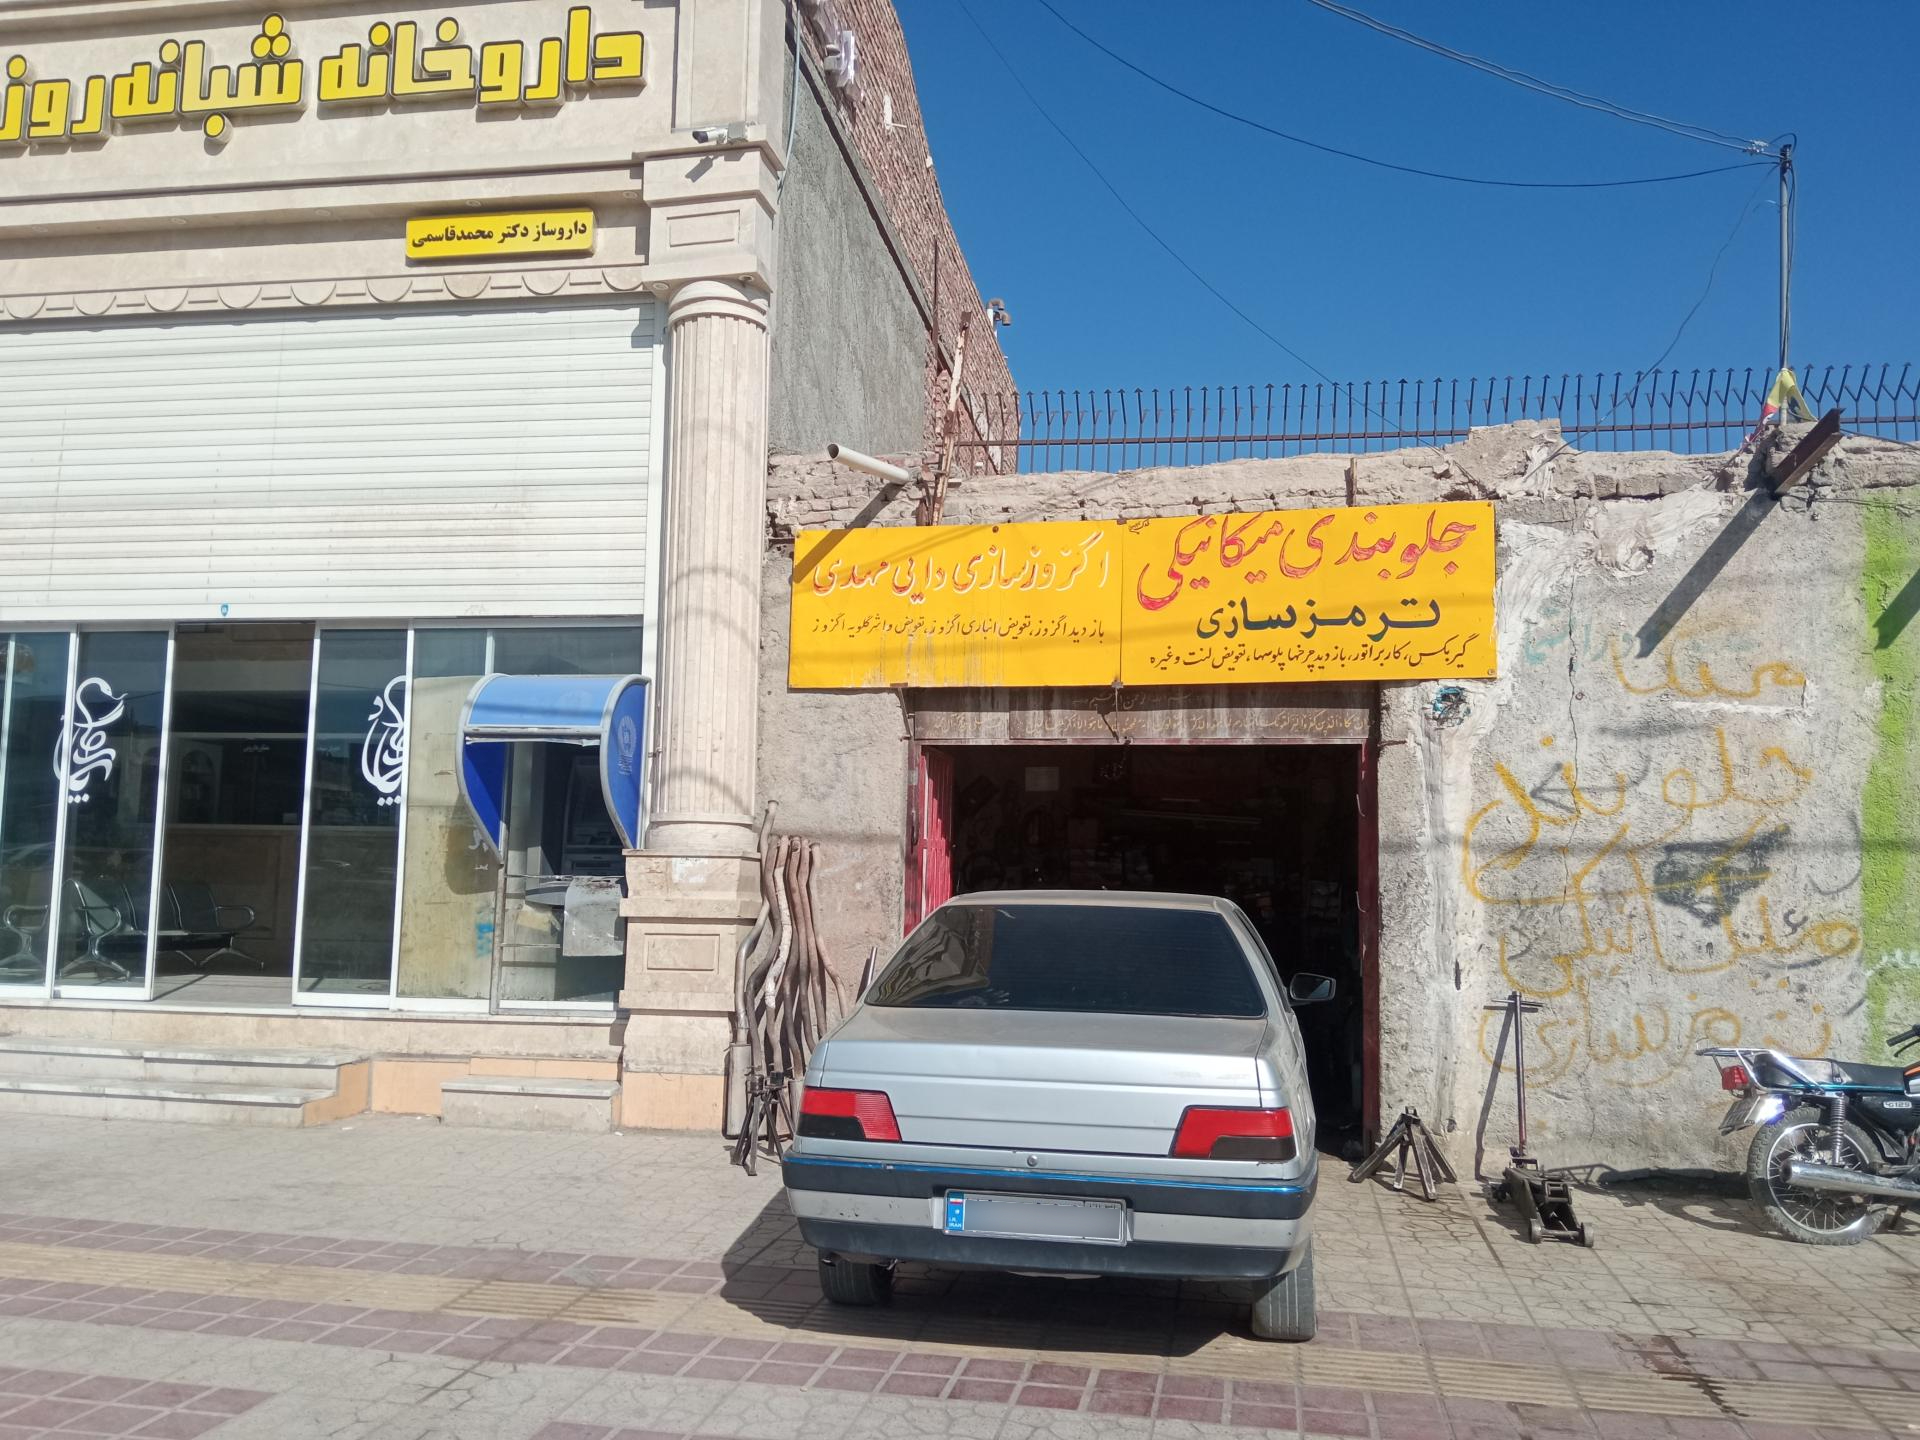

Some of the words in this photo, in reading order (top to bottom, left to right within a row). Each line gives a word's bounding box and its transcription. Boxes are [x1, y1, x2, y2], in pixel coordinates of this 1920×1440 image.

[318, 5, 646, 103] داروخانه
[110, 13, 305, 139] شبانه
[497, 223, 529, 244] دکتر
[533, 220, 587, 242] داروساز
[812, 557, 891, 597] مهدی
[894, 615, 925, 637] تعویض
[962, 617, 997, 640] انباری
[998, 615, 1031, 640] تعویض
[1182, 647, 1212, 666] لنت
[1211, 643, 1246, 672] تعویض
